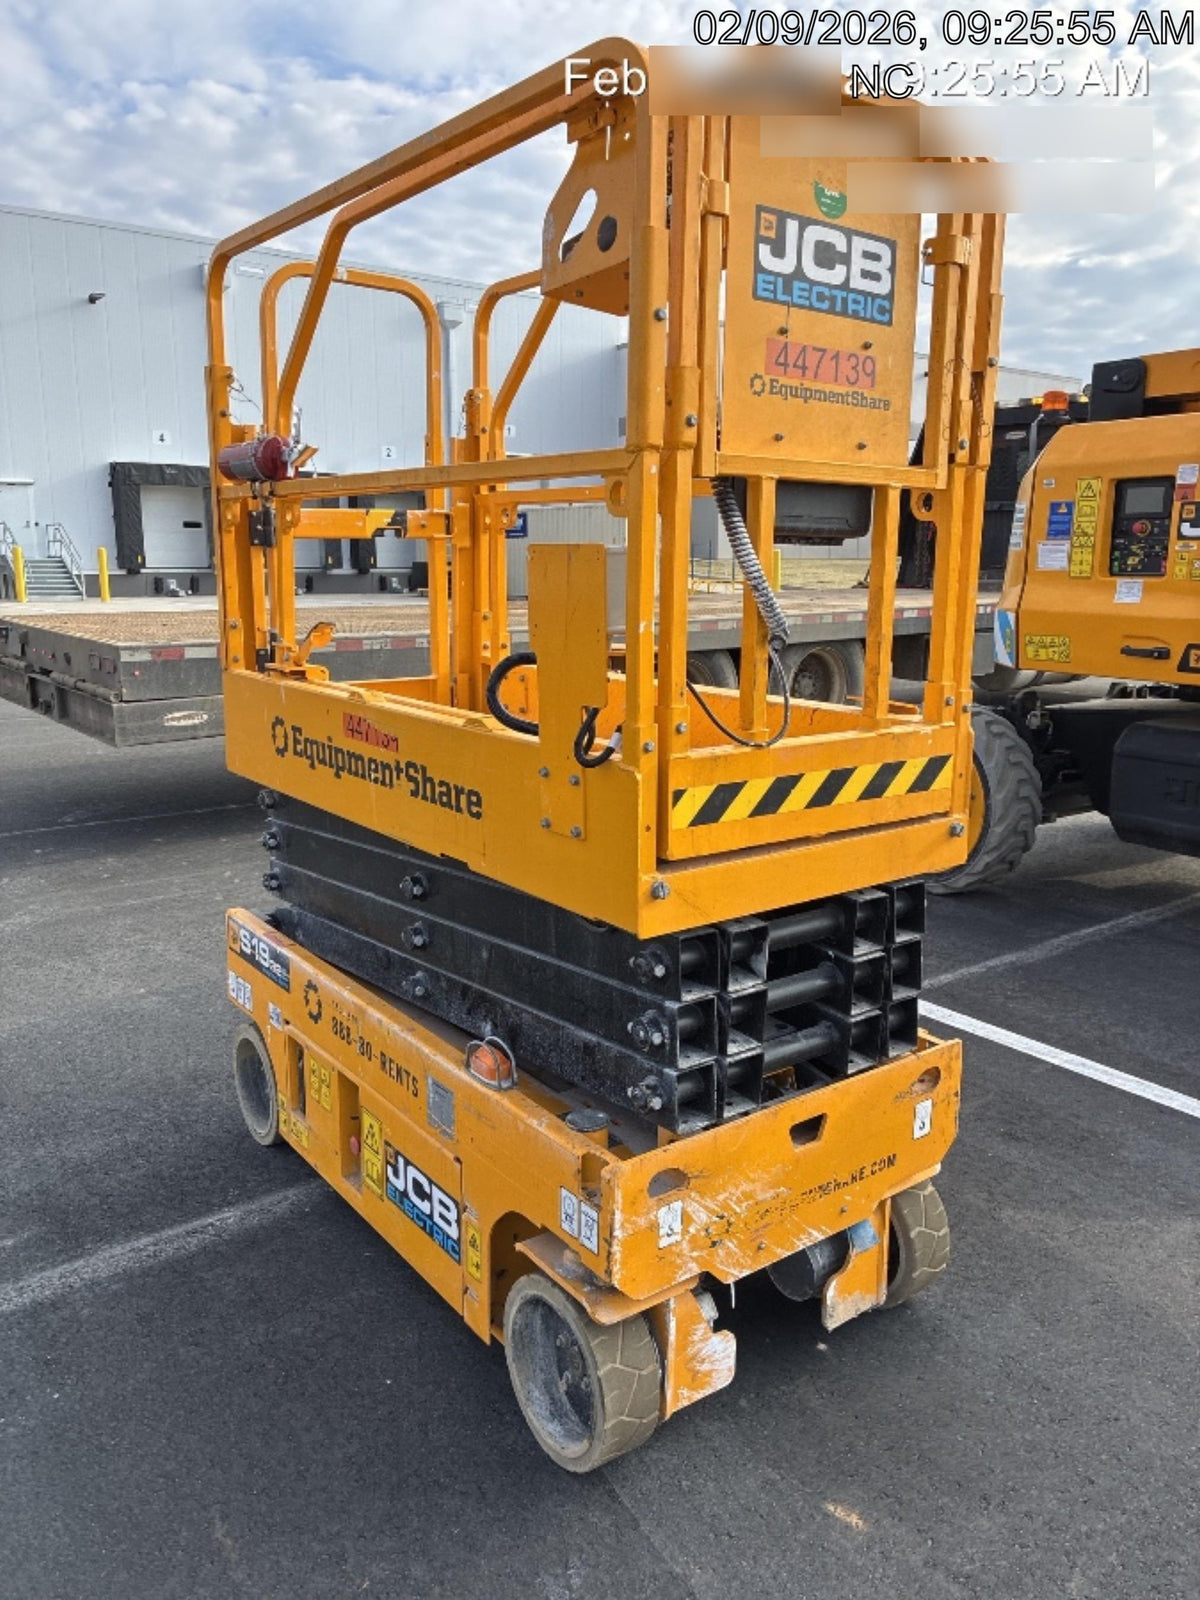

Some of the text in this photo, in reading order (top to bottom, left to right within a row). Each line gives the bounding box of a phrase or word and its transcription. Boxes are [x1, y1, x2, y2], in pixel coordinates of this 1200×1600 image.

[757, 217, 893, 297] JCB
[755, 272, 891, 323] ELECTRIC
[769, 378, 891, 412] EquipmentShare
[774, 341, 877, 387] 447139
[386, 1153, 460, 1242] JCB
[386, 1182, 461, 1260] ELECTRIC
